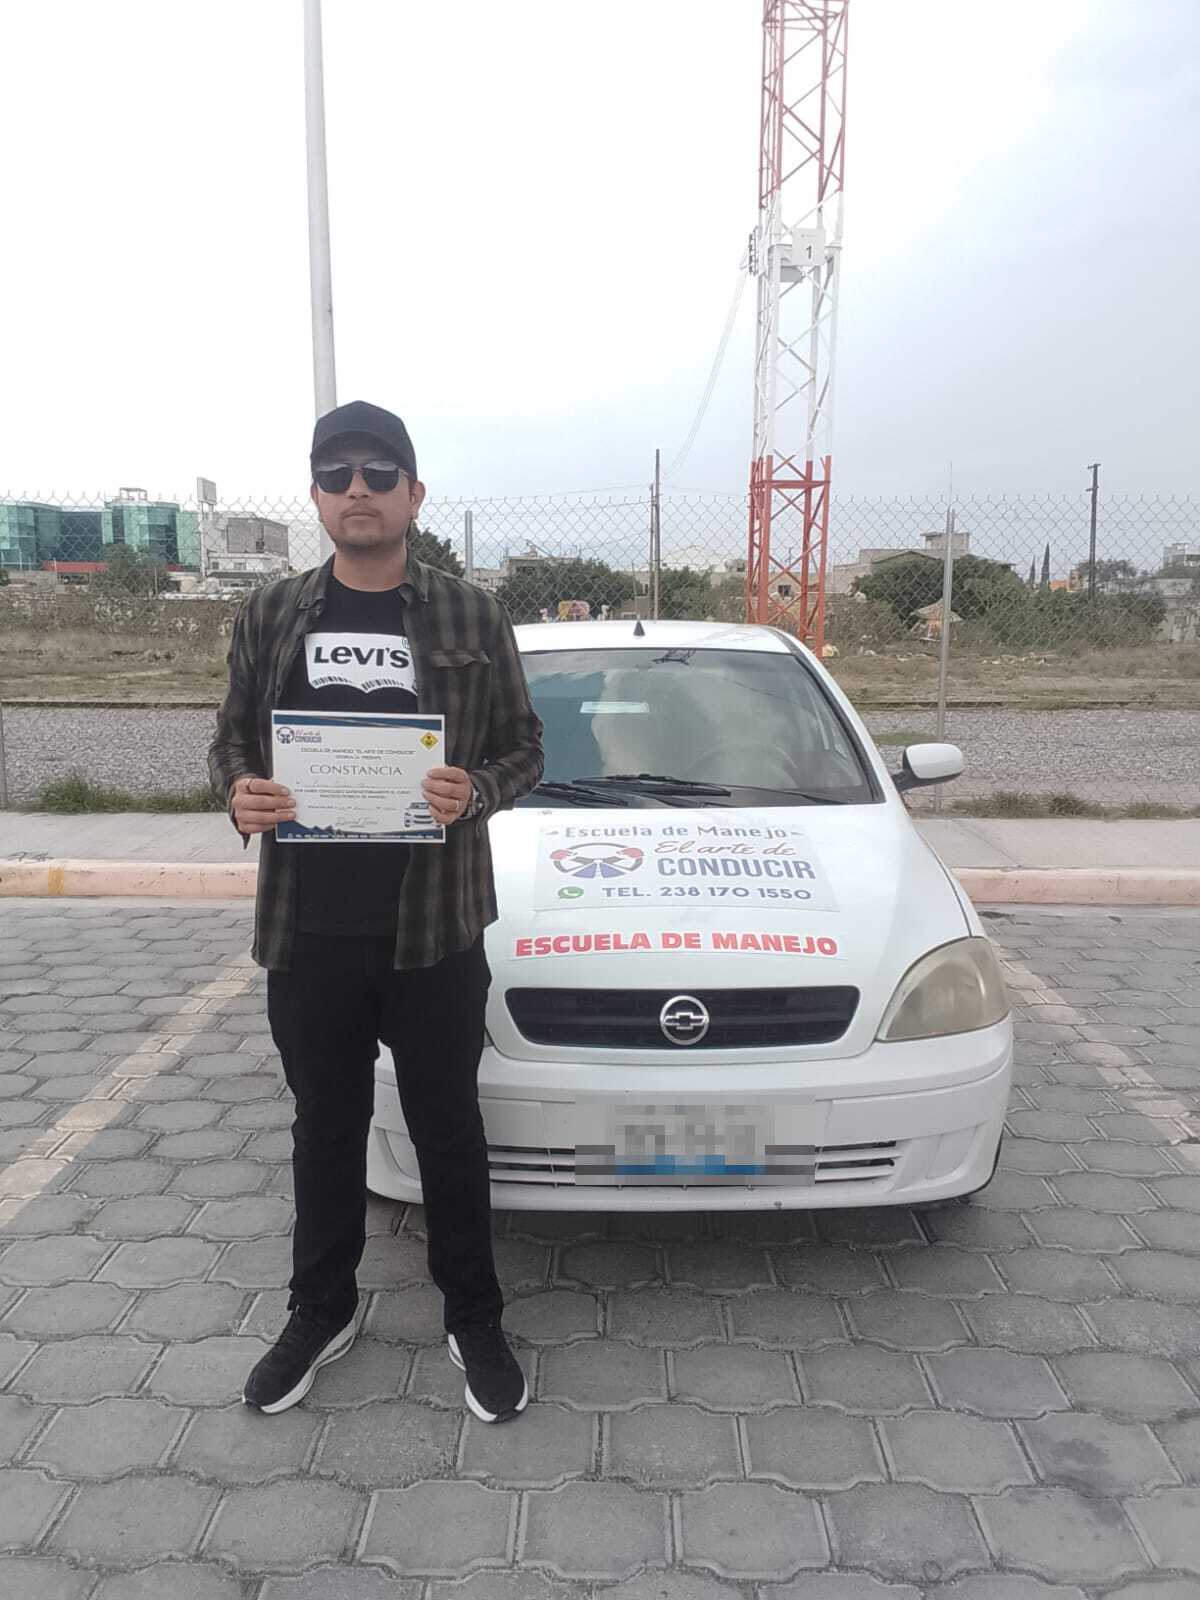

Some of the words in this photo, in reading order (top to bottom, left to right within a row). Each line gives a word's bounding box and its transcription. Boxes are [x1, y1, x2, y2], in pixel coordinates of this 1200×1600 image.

[805, 245, 812, 260] 1
[310, 764, 402, 776] CONSTANCIA
[564, 826, 653, 838] Escuela
[661, 826, 689, 836] de
[697, 826, 788, 840] Manejo
[654, 840, 696, 854] El
[697, 842, 757, 855] arte
[762, 842, 798, 856] de
[657, 857, 817, 880] CONDUCIR
[601, 887, 652, 898] TEL.
[659, 886, 701, 898] 238
[707, 886, 750, 898] 170
[757, 887, 813, 900] 1550
[515, 932, 653, 958] ESCUELA
[661, 932, 702, 950] DE
[711, 932, 839, 957] MANEJO
